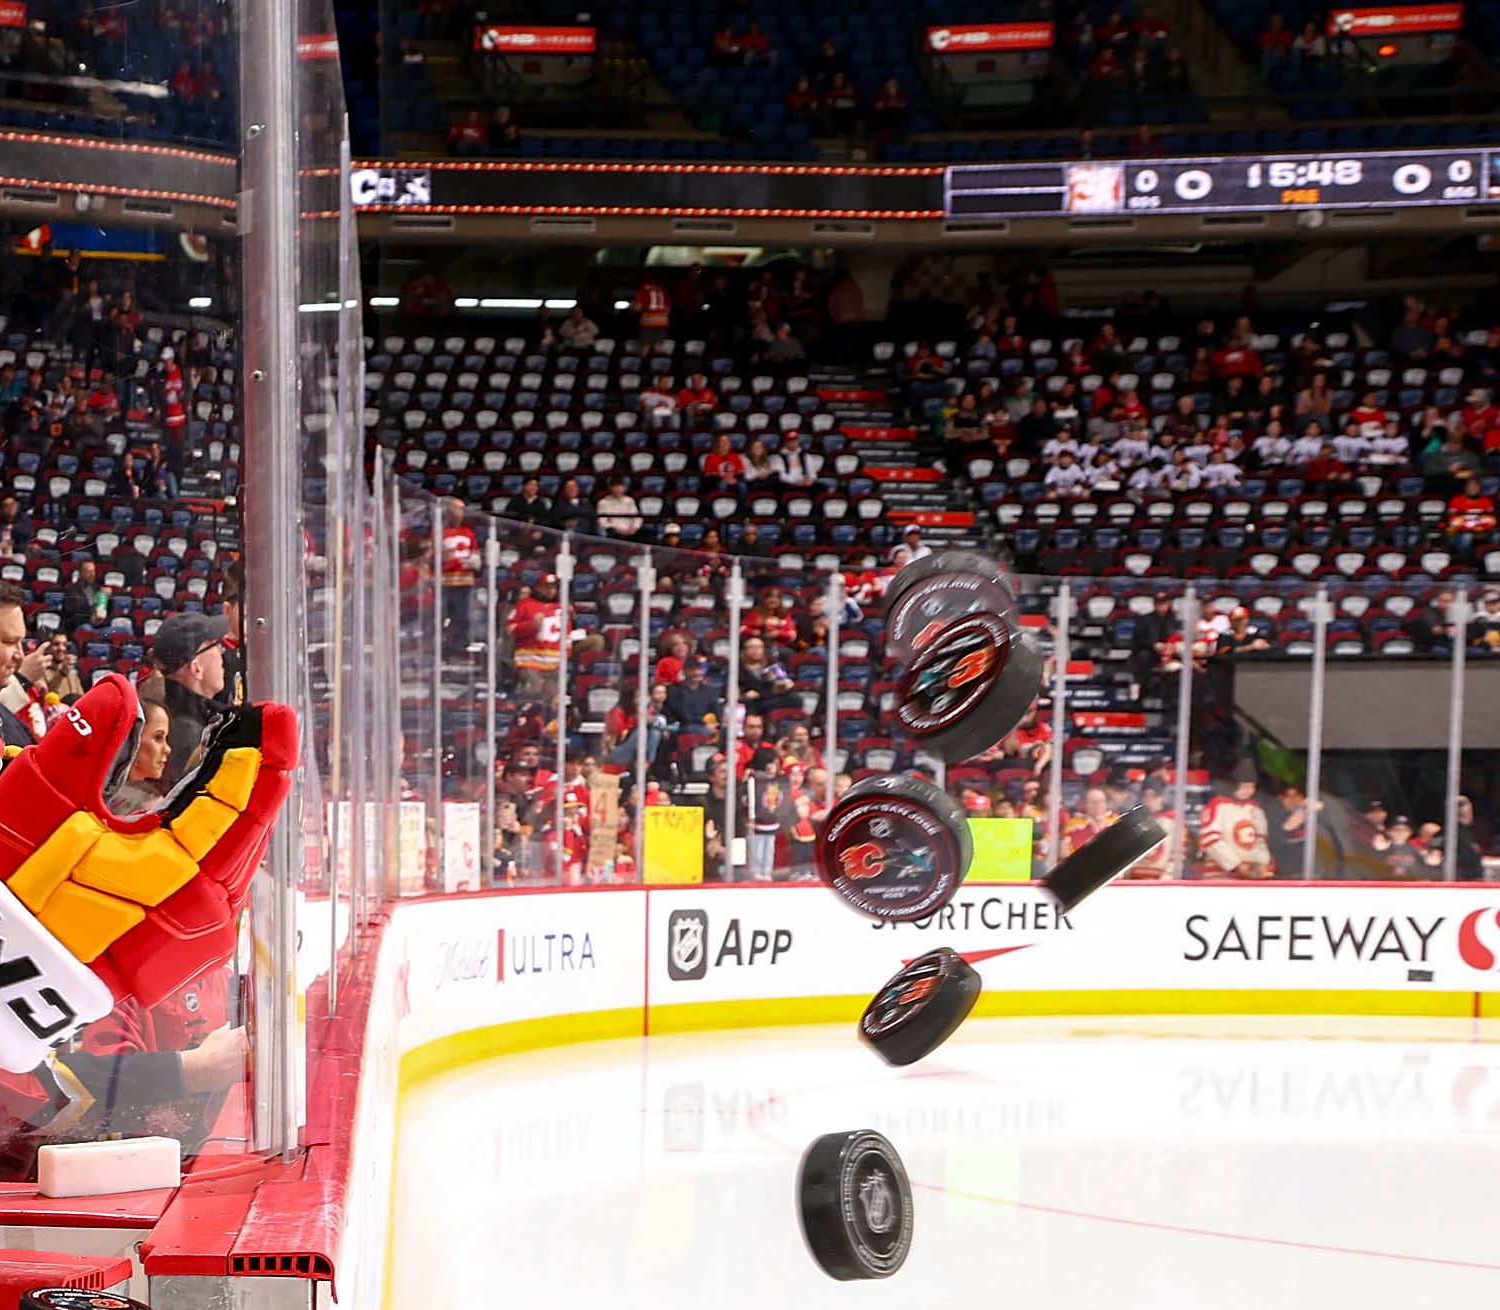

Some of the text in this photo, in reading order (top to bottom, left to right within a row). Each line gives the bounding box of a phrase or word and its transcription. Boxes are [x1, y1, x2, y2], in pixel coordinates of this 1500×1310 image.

[1175, 169, 1213, 200] 0
[1247, 160, 1363, 188] 15:48
[1393, 164, 1432, 194] 0
[872, 898, 1074, 930] RTCHEK
[512, 931, 596, 976] ULTRA
[1184, 914, 1447, 962] SAFEWAY
